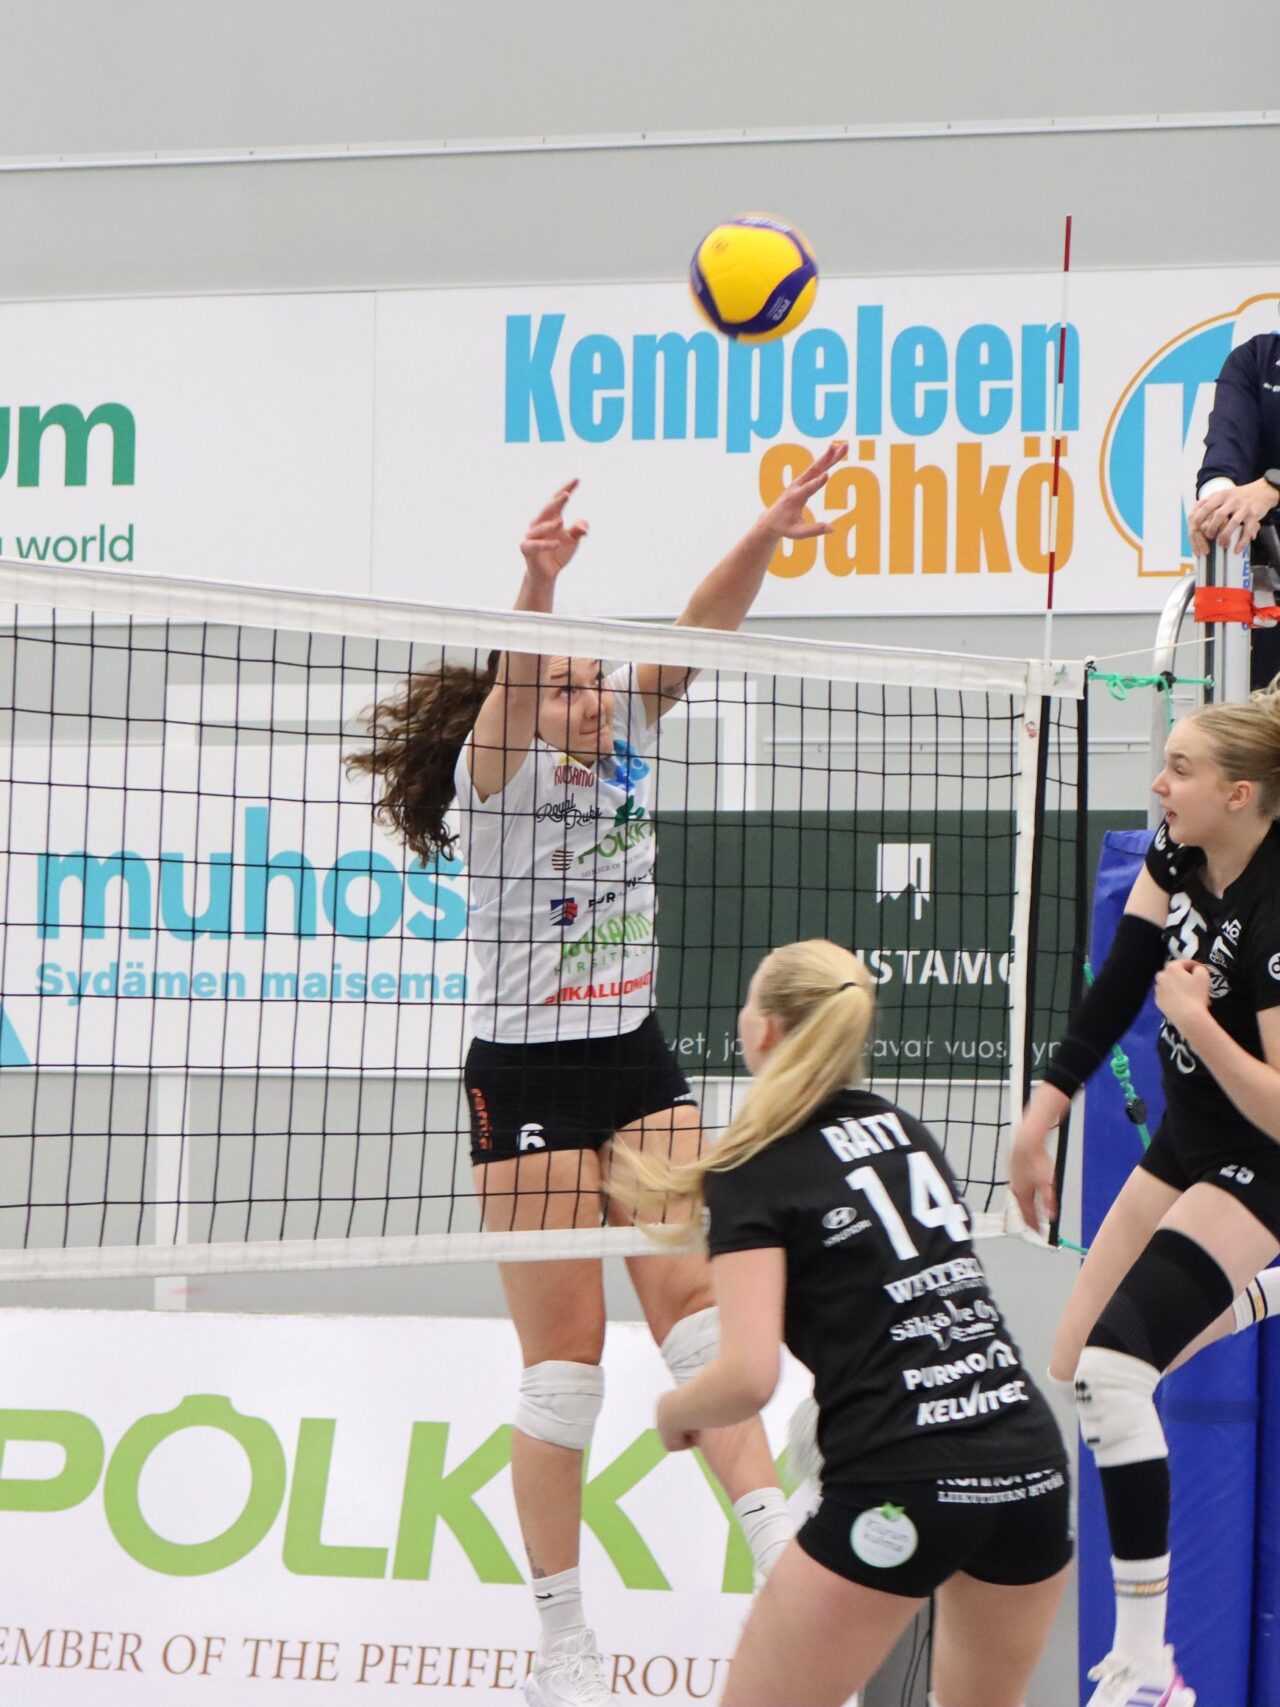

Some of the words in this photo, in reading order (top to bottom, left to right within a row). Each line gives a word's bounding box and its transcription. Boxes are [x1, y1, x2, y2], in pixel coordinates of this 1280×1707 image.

[504, 304, 1080, 453] Kempeleen
[0, 402, 136, 488] m
[758, 436, 1075, 579] Sähkö
[16, 523, 134, 563] world
[36, 806, 469, 943] muhos
[35, 962, 247, 1006] Sydämen
[263, 963, 469, 1000] maisema
[856, 948, 1014, 985] STAM
[820, 1112, 912, 1163] RÄTY
[844, 1150, 973, 1261] 14
[902, 1352, 988, 1391] PURMO
[161, 1633, 225, 1677] OF
[242, 1637, 342, 1682] THE
[607, 1653, 734, 1700] ROU
